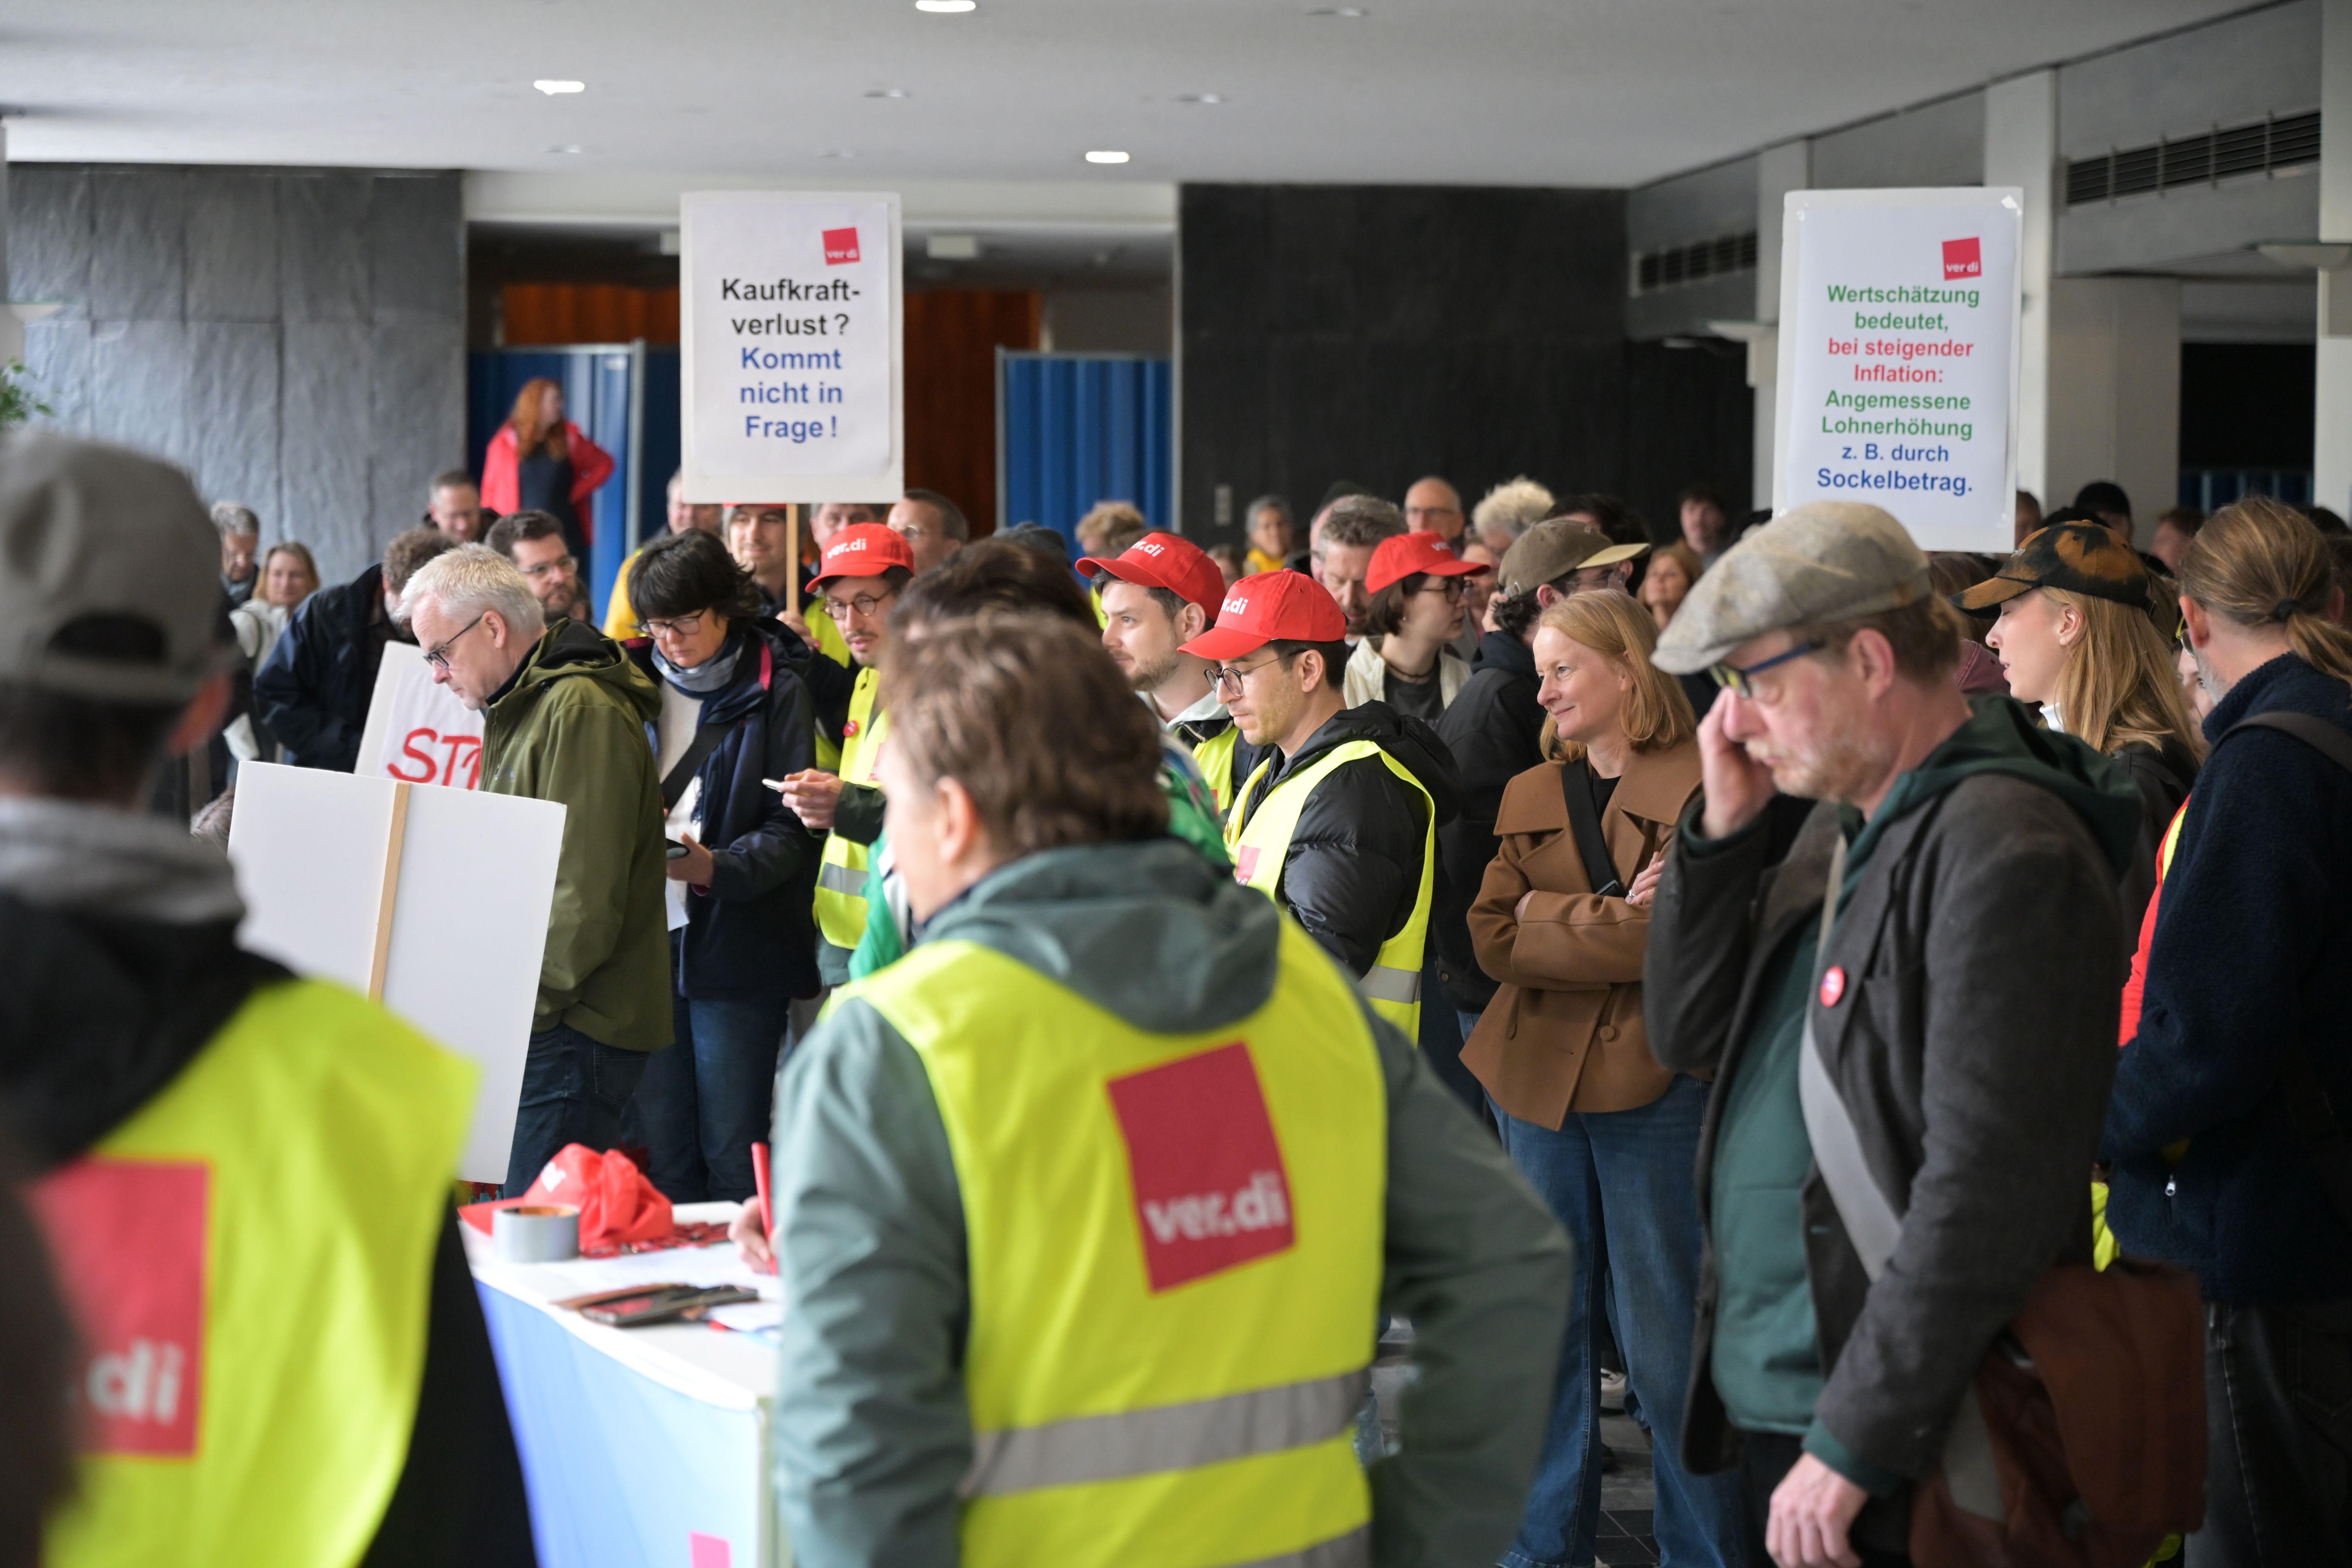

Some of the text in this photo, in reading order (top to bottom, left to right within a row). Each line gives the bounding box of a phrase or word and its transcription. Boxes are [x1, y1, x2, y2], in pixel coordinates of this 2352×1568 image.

[721, 278, 861, 302] Kaufkraft-
[1827, 285, 1980, 309] Wertschätzung
[1854, 311, 1949, 333] bedeutet,
[741, 346, 842, 370] Kommt
[1828, 337, 1974, 361] bei steigender
[1854, 364, 1943, 383] Inflation:
[740, 381, 843, 404] nicht in
[1825, 389, 1971, 413] Angemessene
[1822, 416, 1973, 442] Lohnerhöhung
[1891, 443, 1949, 462] durch
[1816, 467, 1973, 497] Sockelbetrag.
[827, 538, 866, 559] ver.di
[1142, 1170, 1288, 1244] ver.di
